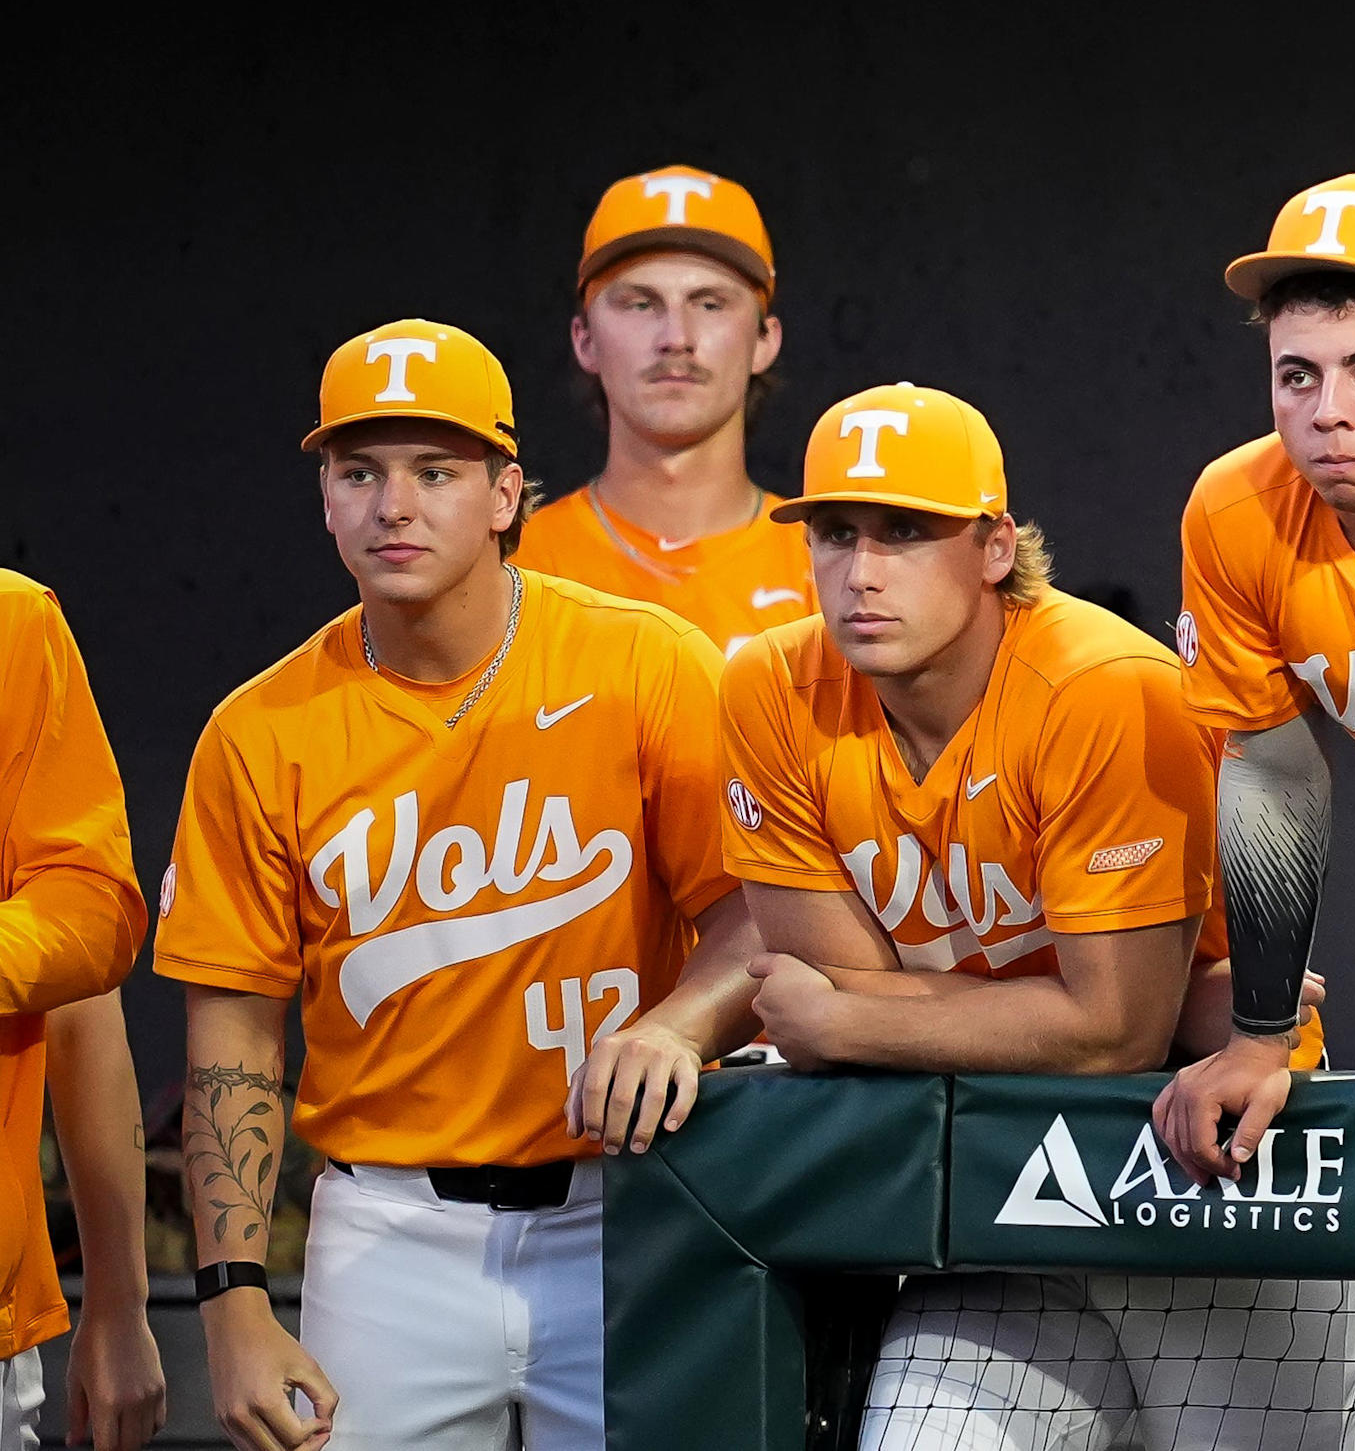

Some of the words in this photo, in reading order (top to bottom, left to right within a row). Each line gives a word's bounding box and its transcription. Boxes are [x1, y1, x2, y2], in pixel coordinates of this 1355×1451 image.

[638, 172, 718, 226] T
[366, 337, 438, 403] T
[838, 408, 910, 479] T
[309, 778, 618, 943] Vols
[525, 967, 640, 1088] 42
[1113, 1201, 1341, 1233] LOGISTICS
